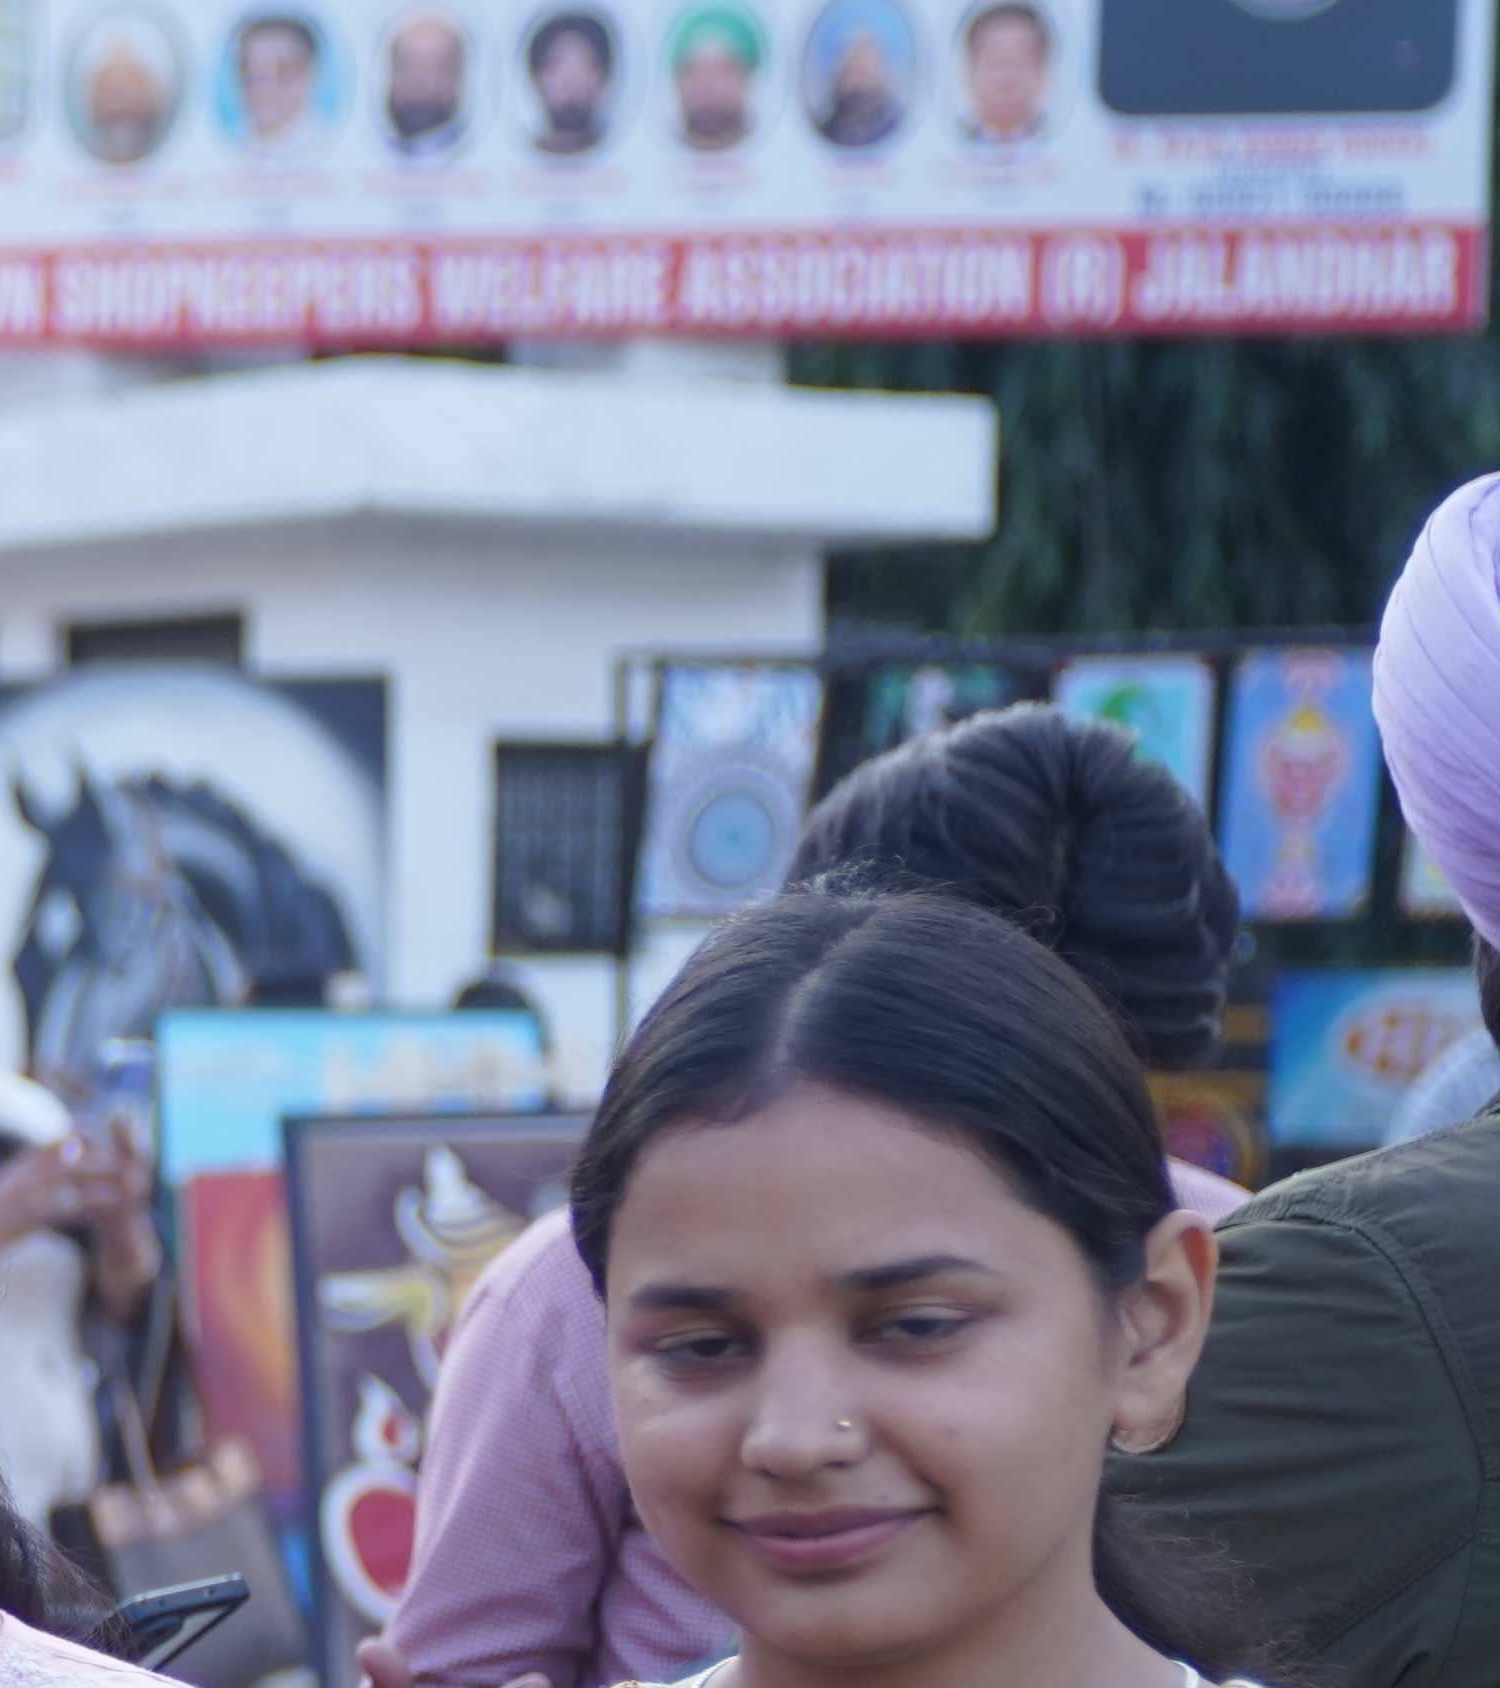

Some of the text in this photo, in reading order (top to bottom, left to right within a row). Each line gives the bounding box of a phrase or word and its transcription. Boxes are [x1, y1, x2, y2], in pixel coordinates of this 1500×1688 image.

[58, 250, 419, 336] SHOPKEEPERS
[436, 242, 666, 324] WELFARE
[680, 236, 1032, 320] ASSOCIATION
[1141, 230, 1457, 318] JALANDHAR
